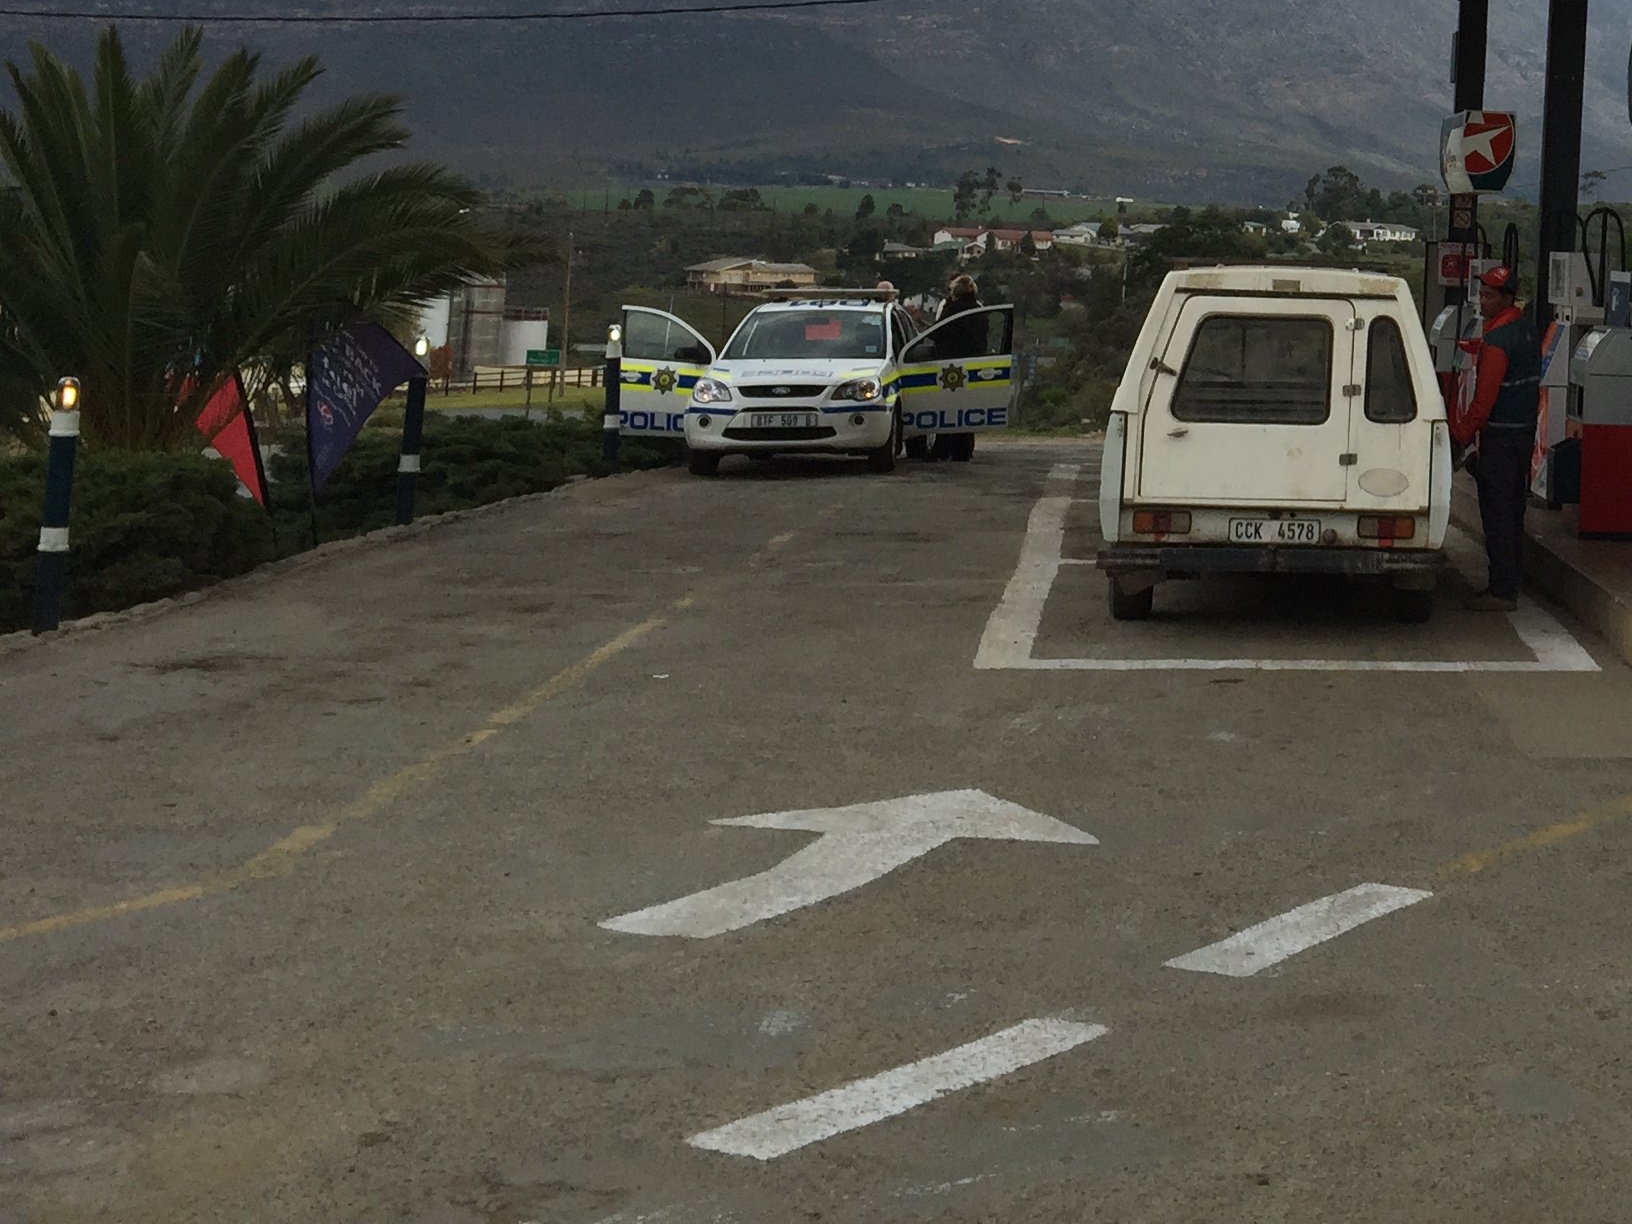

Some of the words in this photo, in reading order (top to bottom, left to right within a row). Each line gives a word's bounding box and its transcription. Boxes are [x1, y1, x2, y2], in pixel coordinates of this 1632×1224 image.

[619, 411, 685, 432] POLIC
[902, 407, 1007, 429] POLICE
[1235, 522, 1263, 540] CCK
[1278, 522, 1314, 540] 4578
